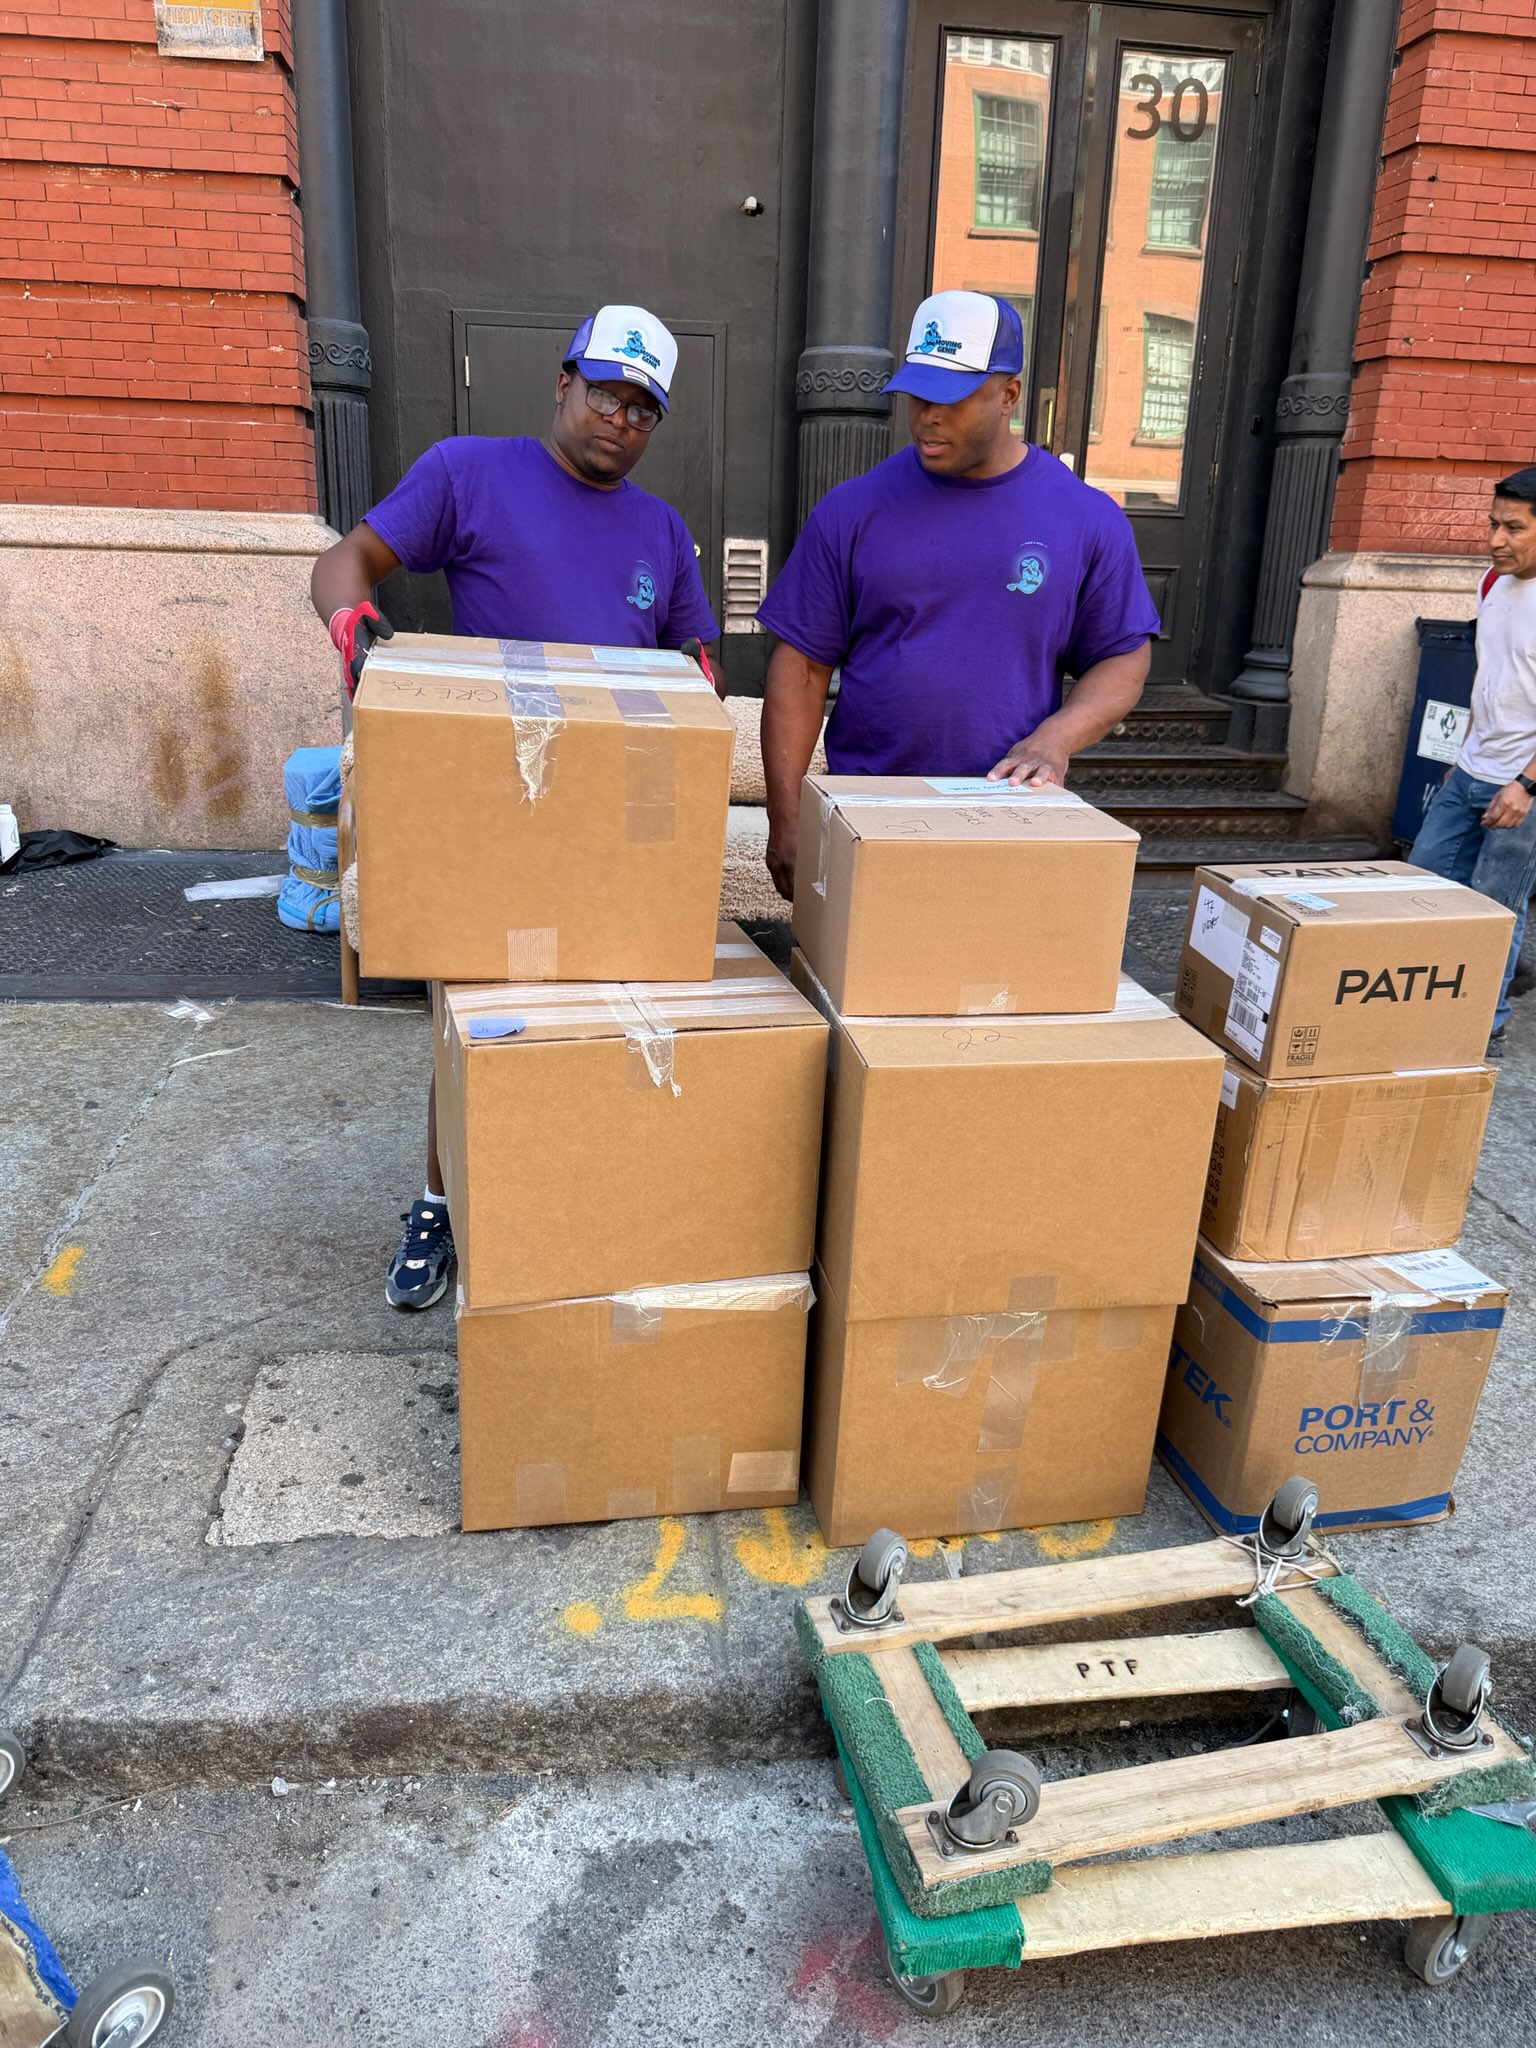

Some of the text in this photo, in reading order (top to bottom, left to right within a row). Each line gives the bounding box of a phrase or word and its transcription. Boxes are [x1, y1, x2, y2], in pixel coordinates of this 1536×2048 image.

[1126, 73, 1209, 142] 30
[936, 339, 962, 349] MOVING
[936, 346, 957, 355] GENIE
[1257, 866, 1390, 878] PATH
[1334, 963, 1466, 1006] PATH
[1286, 1053, 1315, 1063] FRAGILE
[1298, 1398, 1436, 1433] PORT &
[1293, 1424, 1433, 1455] COMPANY
[1075, 1659, 1138, 1679] PTF
